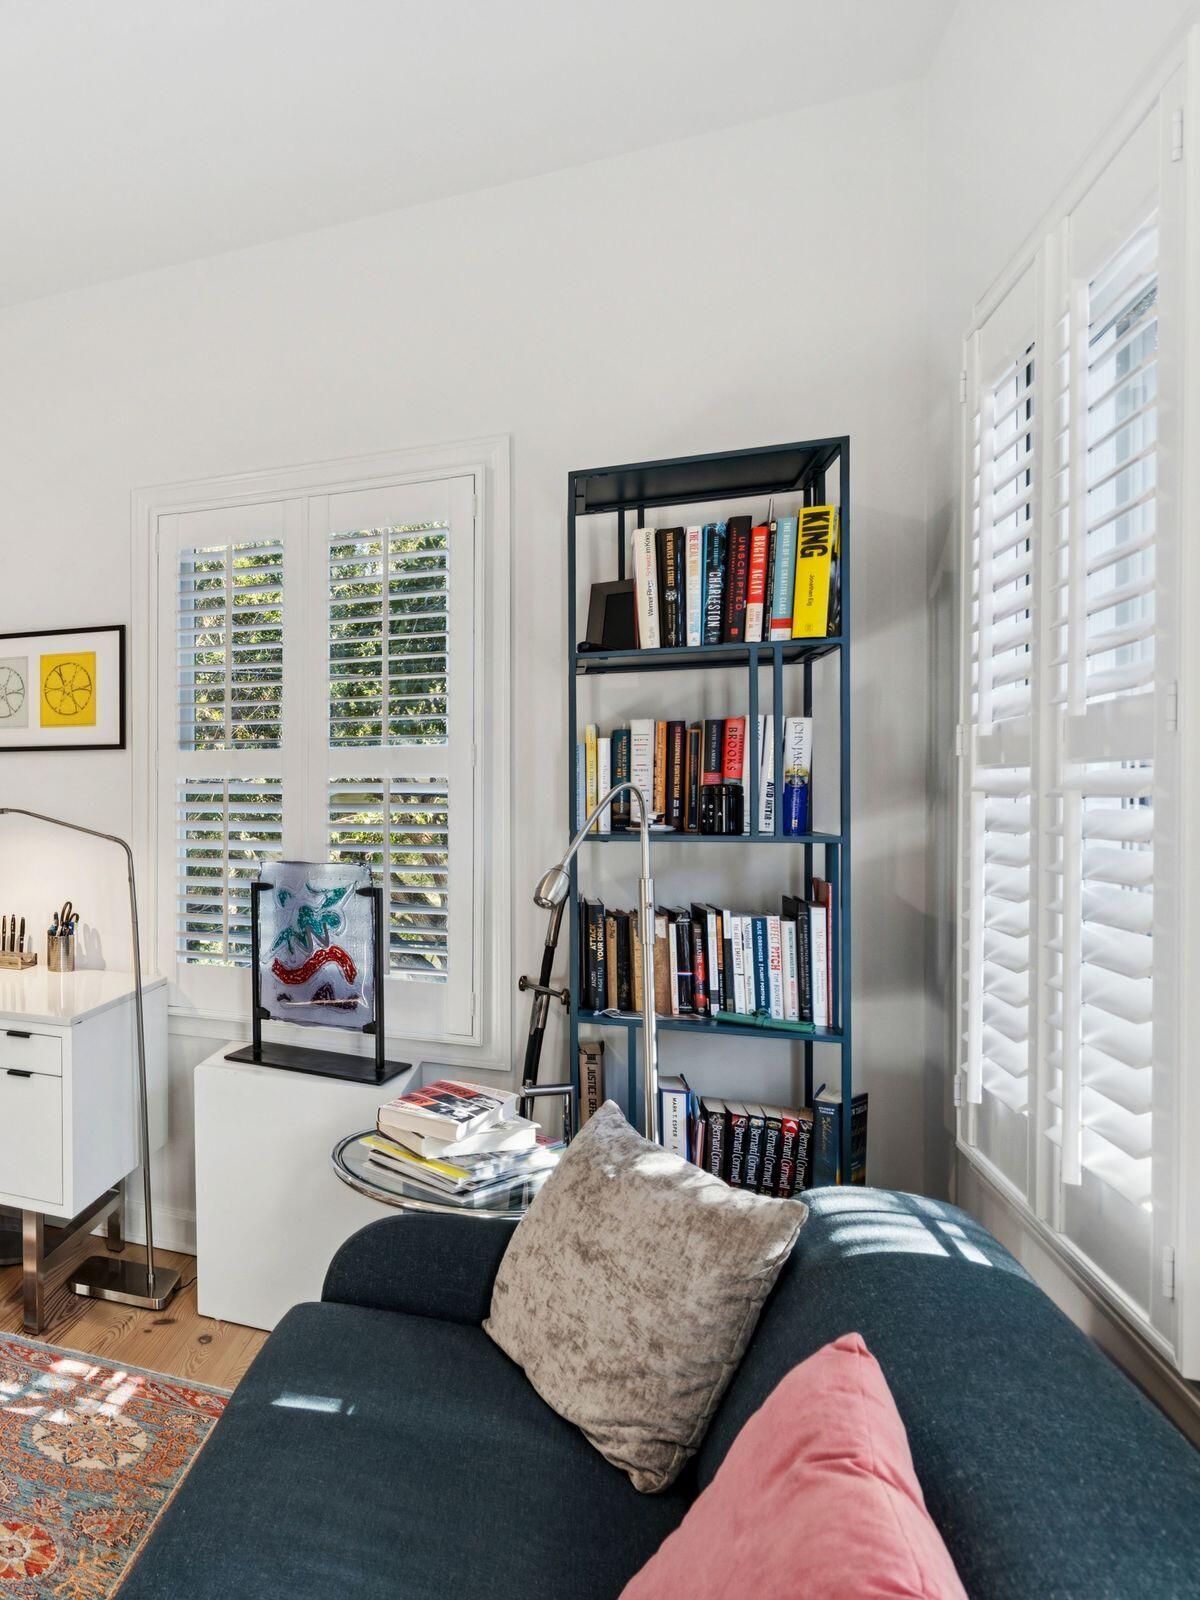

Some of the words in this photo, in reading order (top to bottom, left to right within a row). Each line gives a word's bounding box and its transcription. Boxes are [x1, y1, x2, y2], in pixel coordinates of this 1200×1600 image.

[666, 532, 674, 541] THE
[689, 531, 699, 542] THE
[783, 522, 791, 532] THE
[800, 511, 830, 559] KING
[689, 543, 699, 558] REAL
[753, 536, 765, 563] BEGIN
[782, 535, 790, 547] RISE
[667, 571, 675, 587] STREET
[735, 536, 746, 611] UNSCRIPTED
[750, 569, 763, 595] AGAIN
[780, 570, 789, 596] CREATIVE
[707, 571, 722, 627] CHARLESTON
[779, 597, 787, 614] CLASS
[806, 598, 814, 607] Eig
[792, 721, 805, 747] JOHN
[727, 727, 738, 771] BROOKS
[792, 747, 805, 775] JAKES
[766, 781, 774, 798] AYAD
[764, 799, 772, 820] AKHTAR
[744, 923, 753, 950] Negroland
[770, 919, 780, 945] PERFECT
[770, 946, 780, 971] PITCH
[773, 984, 781, 1007] BOUVERIE
[587, 1067, 597, 1095] JUSTICE
[711, 1124, 723, 1150] Bernard
[733, 1127, 746, 1153] Bernard
[749, 1128, 763, 1155] Bernard
[766, 1129, 780, 1156] Bernard
[781, 1131, 795, 1159] Bernard
[797, 1132, 810, 1159] Bernard
[731, 1154, 743, 1183] Cornwell
[746, 1155, 759, 1185] Cornwell
[762, 1157, 775, 1187] Cornwell
[779, 1159, 792, 1189] Cornwell
[794, 1160, 806, 1190] Cornwell
